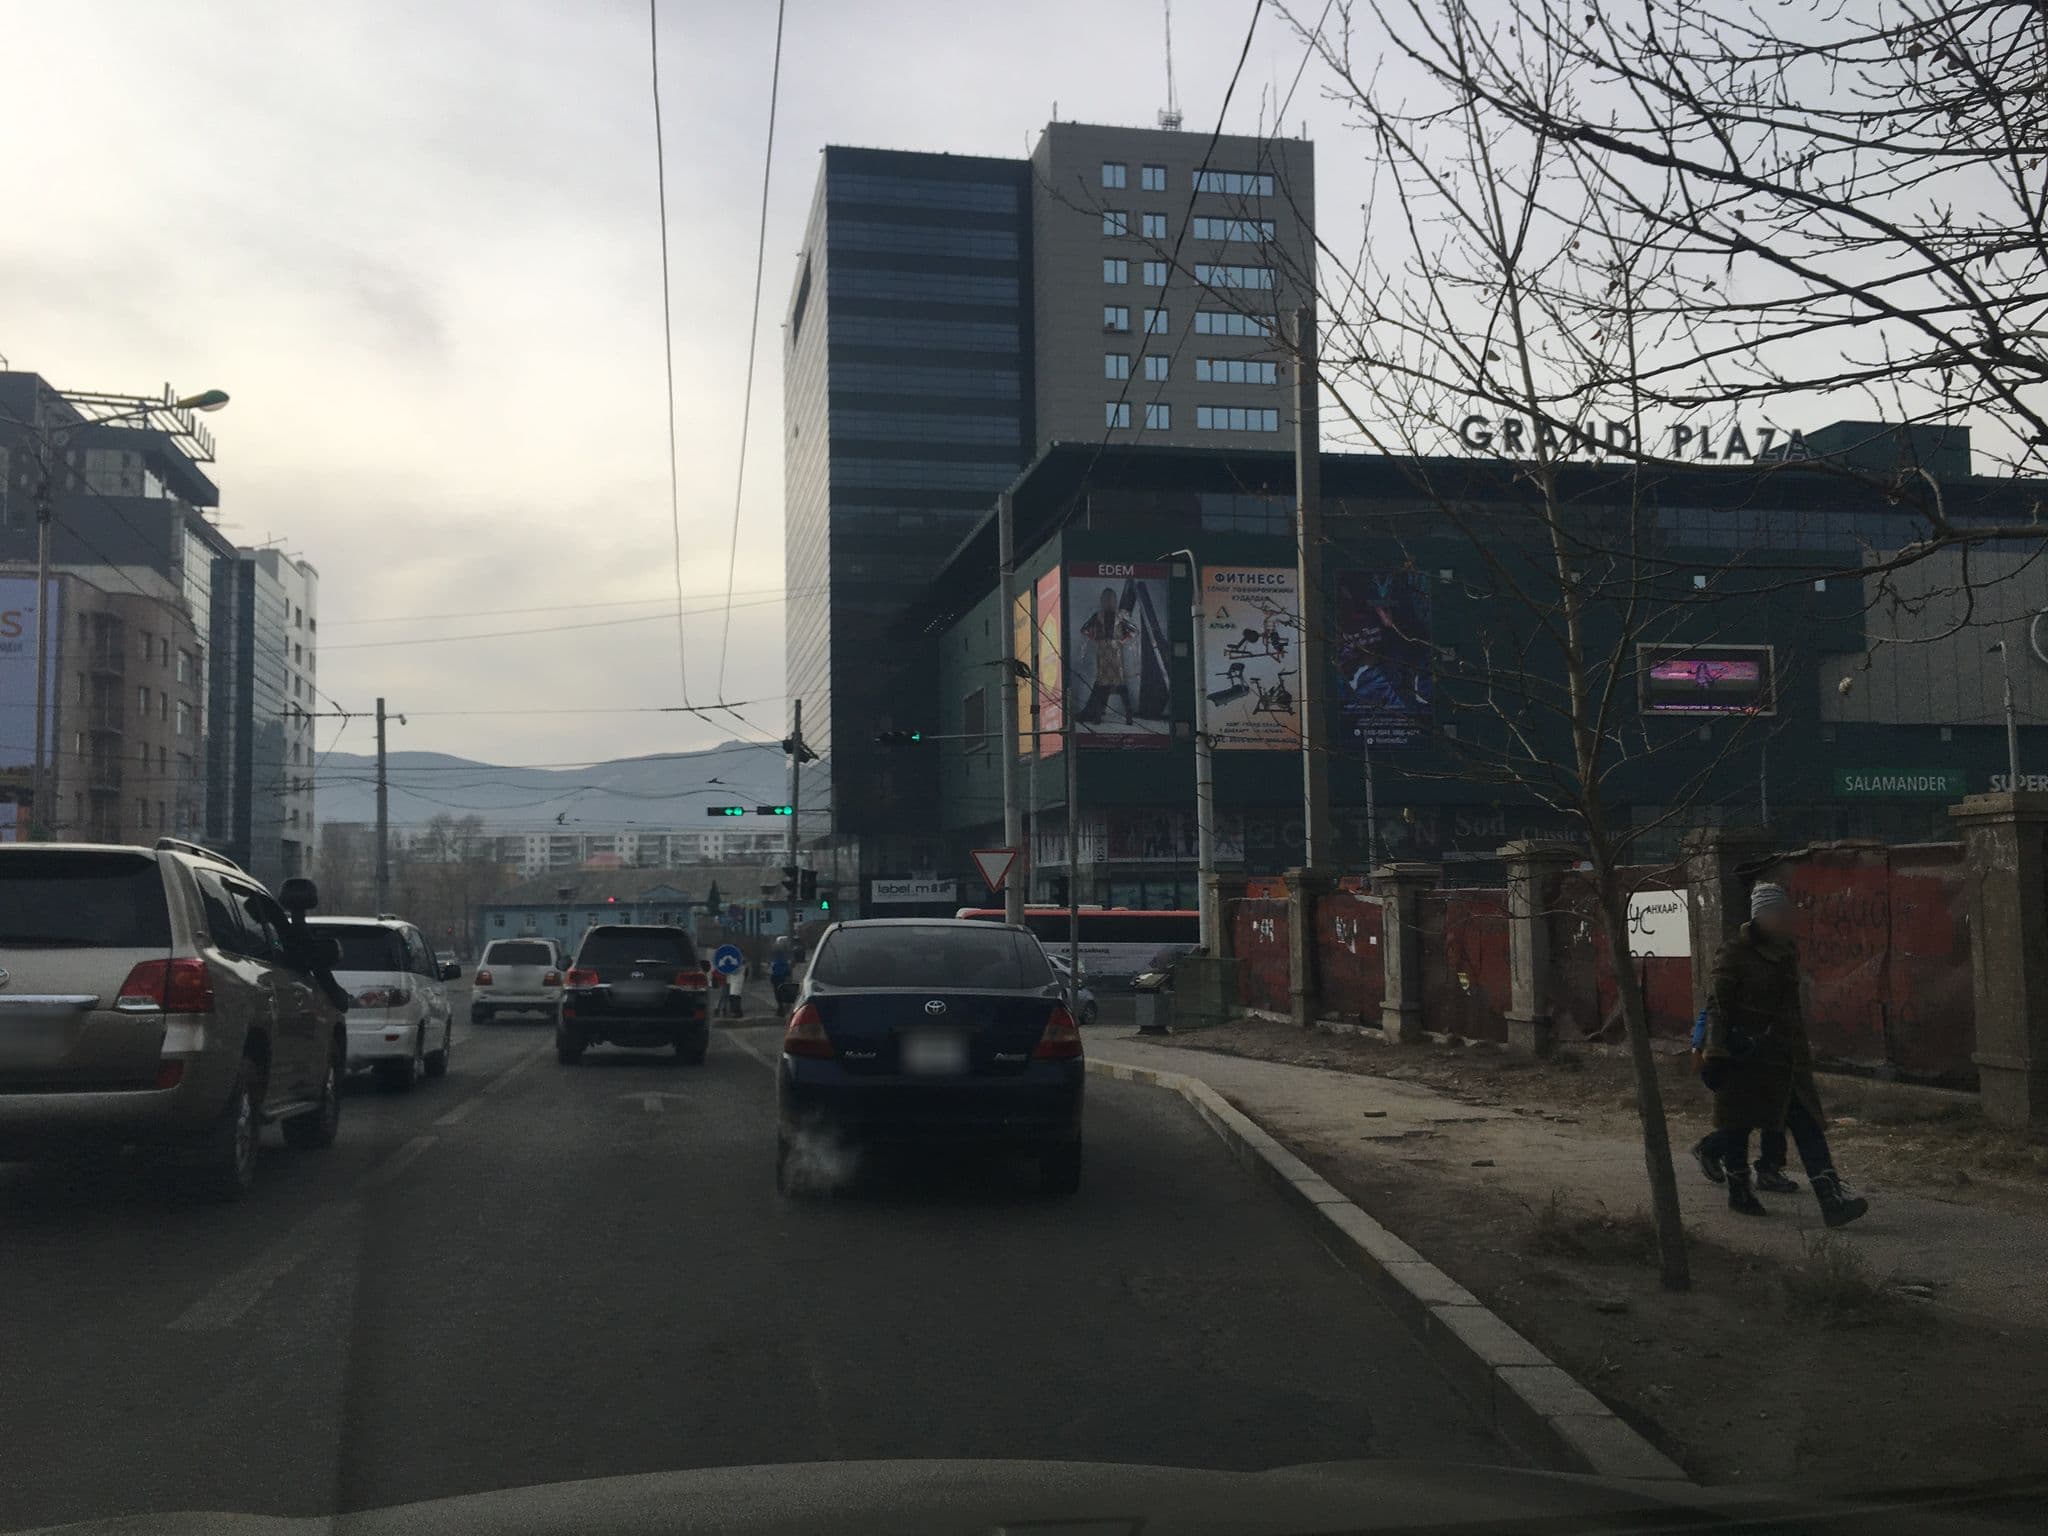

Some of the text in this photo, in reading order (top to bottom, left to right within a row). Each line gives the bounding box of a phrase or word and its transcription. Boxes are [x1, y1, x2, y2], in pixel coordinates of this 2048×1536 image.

[1460, 415, 1812, 462] GRAND PLAZA
[1098, 565, 1134, 576] EDEM
[1215, 573, 1285, 584] ФИТНЕСС
[1845, 776, 1946, 791] SALAMANDER
